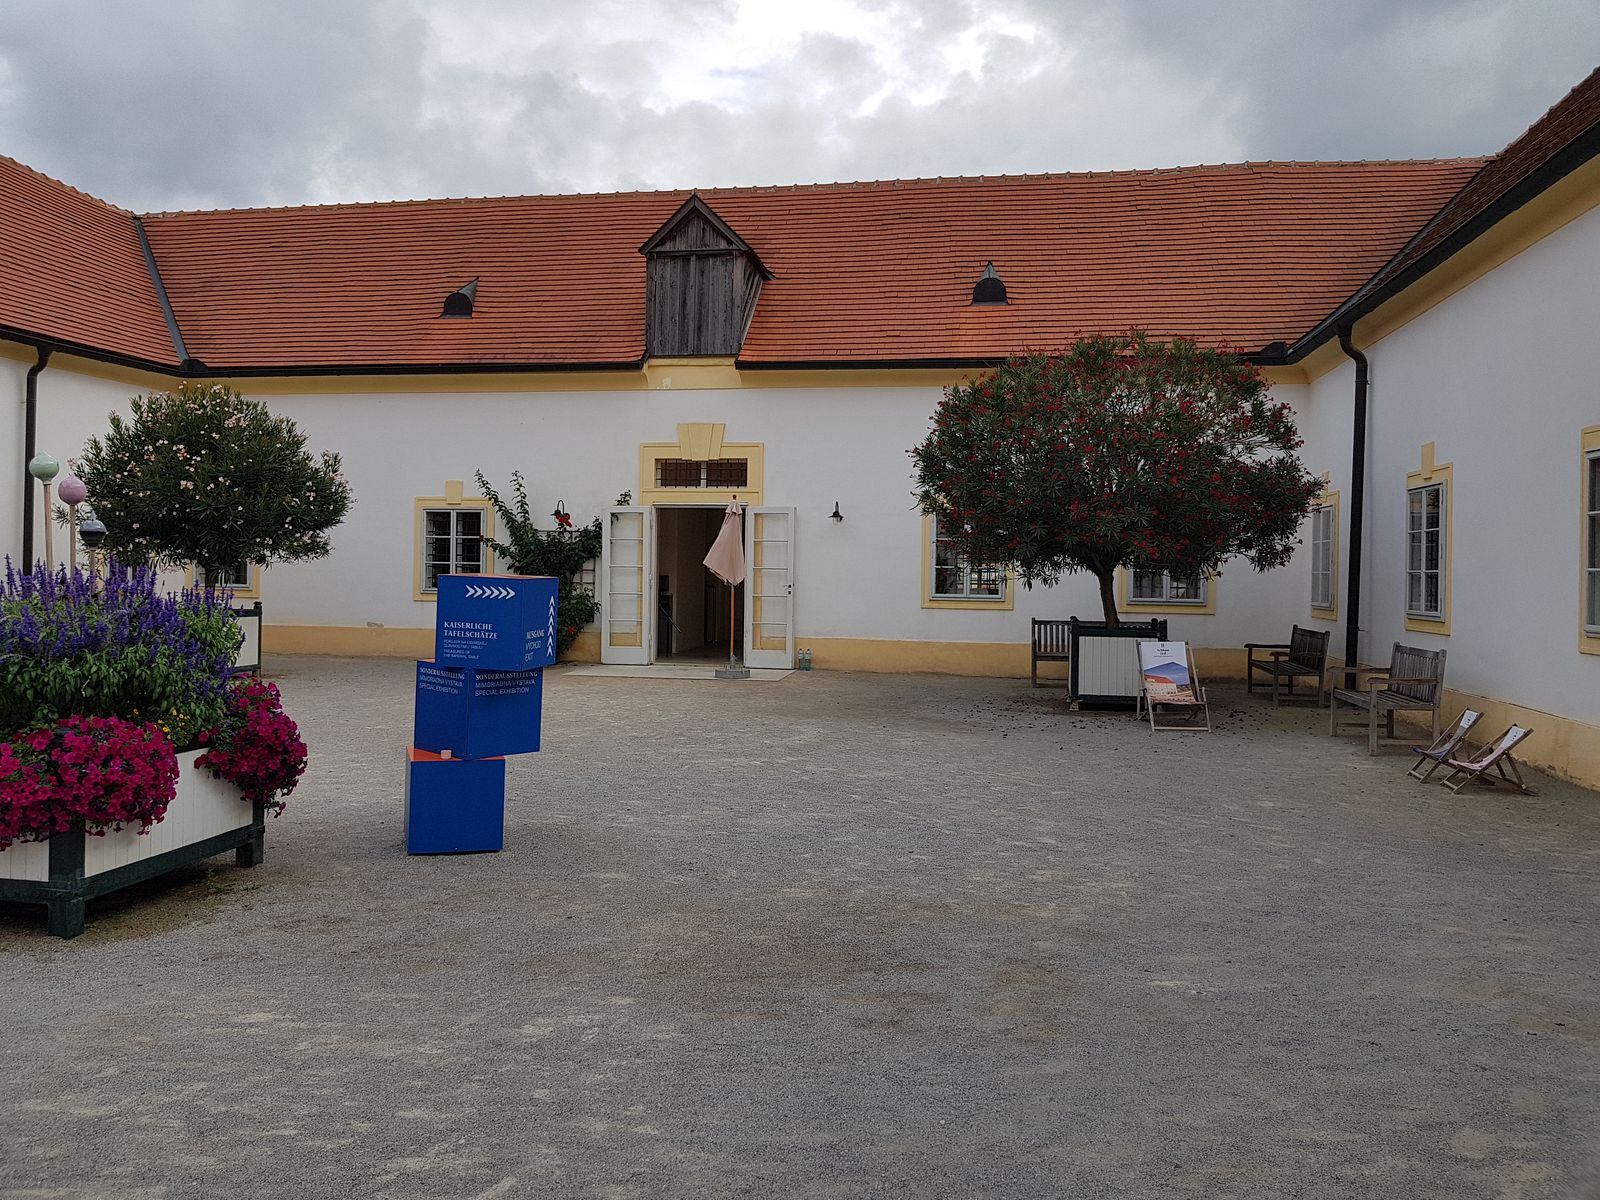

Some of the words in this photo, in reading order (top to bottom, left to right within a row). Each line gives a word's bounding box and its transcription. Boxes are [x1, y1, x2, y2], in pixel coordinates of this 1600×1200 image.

[444, 621, 493, 631] KAISERLICHE
[443, 630, 498, 640] TAFELSCHÄTZE
[526, 629, 545, 639] AUSGANG
[525, 652, 534, 662] EXIT
[419, 667, 465, 680] SONDERAUSSTELLUNG
[475, 671, 538, 681] SONDERAUSSTELLUNG
[419, 682, 435, 690] SPECIAL
[436, 685, 459, 695] EXHIBITION
[475, 689, 498, 698] SPECIAL
[499, 687, 530, 695] EXHIBITION
